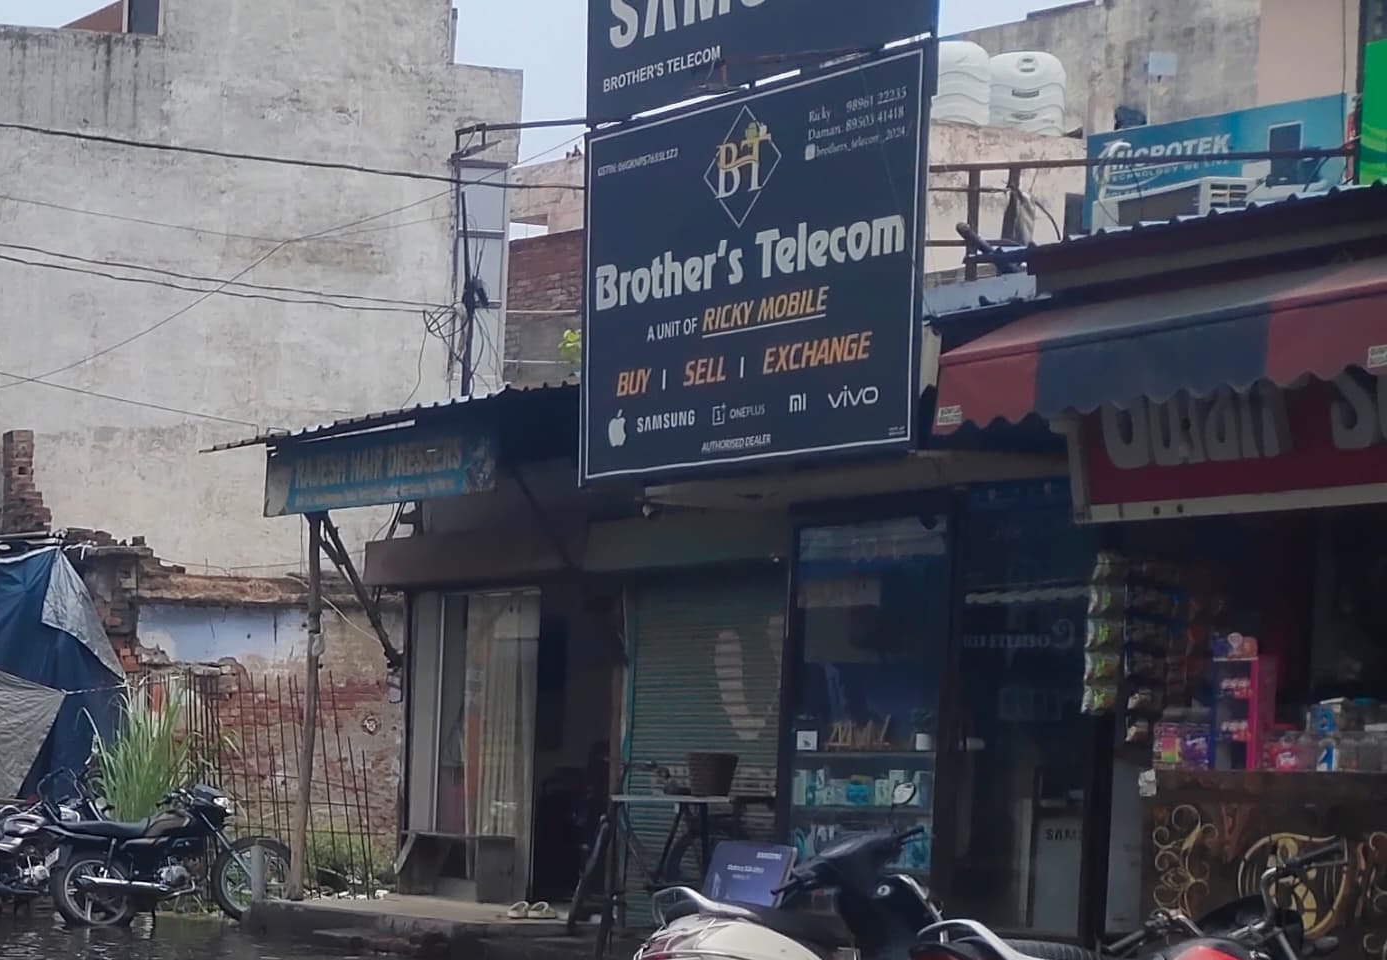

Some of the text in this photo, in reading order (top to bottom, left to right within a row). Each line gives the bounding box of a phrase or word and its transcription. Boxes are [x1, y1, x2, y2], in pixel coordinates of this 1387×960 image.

[602, 45, 721, 93] BROTHER'S TELECOM
[595, 214, 906, 311] Brother's Telecom
[647, 286, 830, 343] A UNIT OF RICKY MOBILE
[616, 331, 873, 397] BUY SELL EXCHANGE
[636, 409, 695, 434] SAMSUNG
[828, 385, 879, 409] vivo
